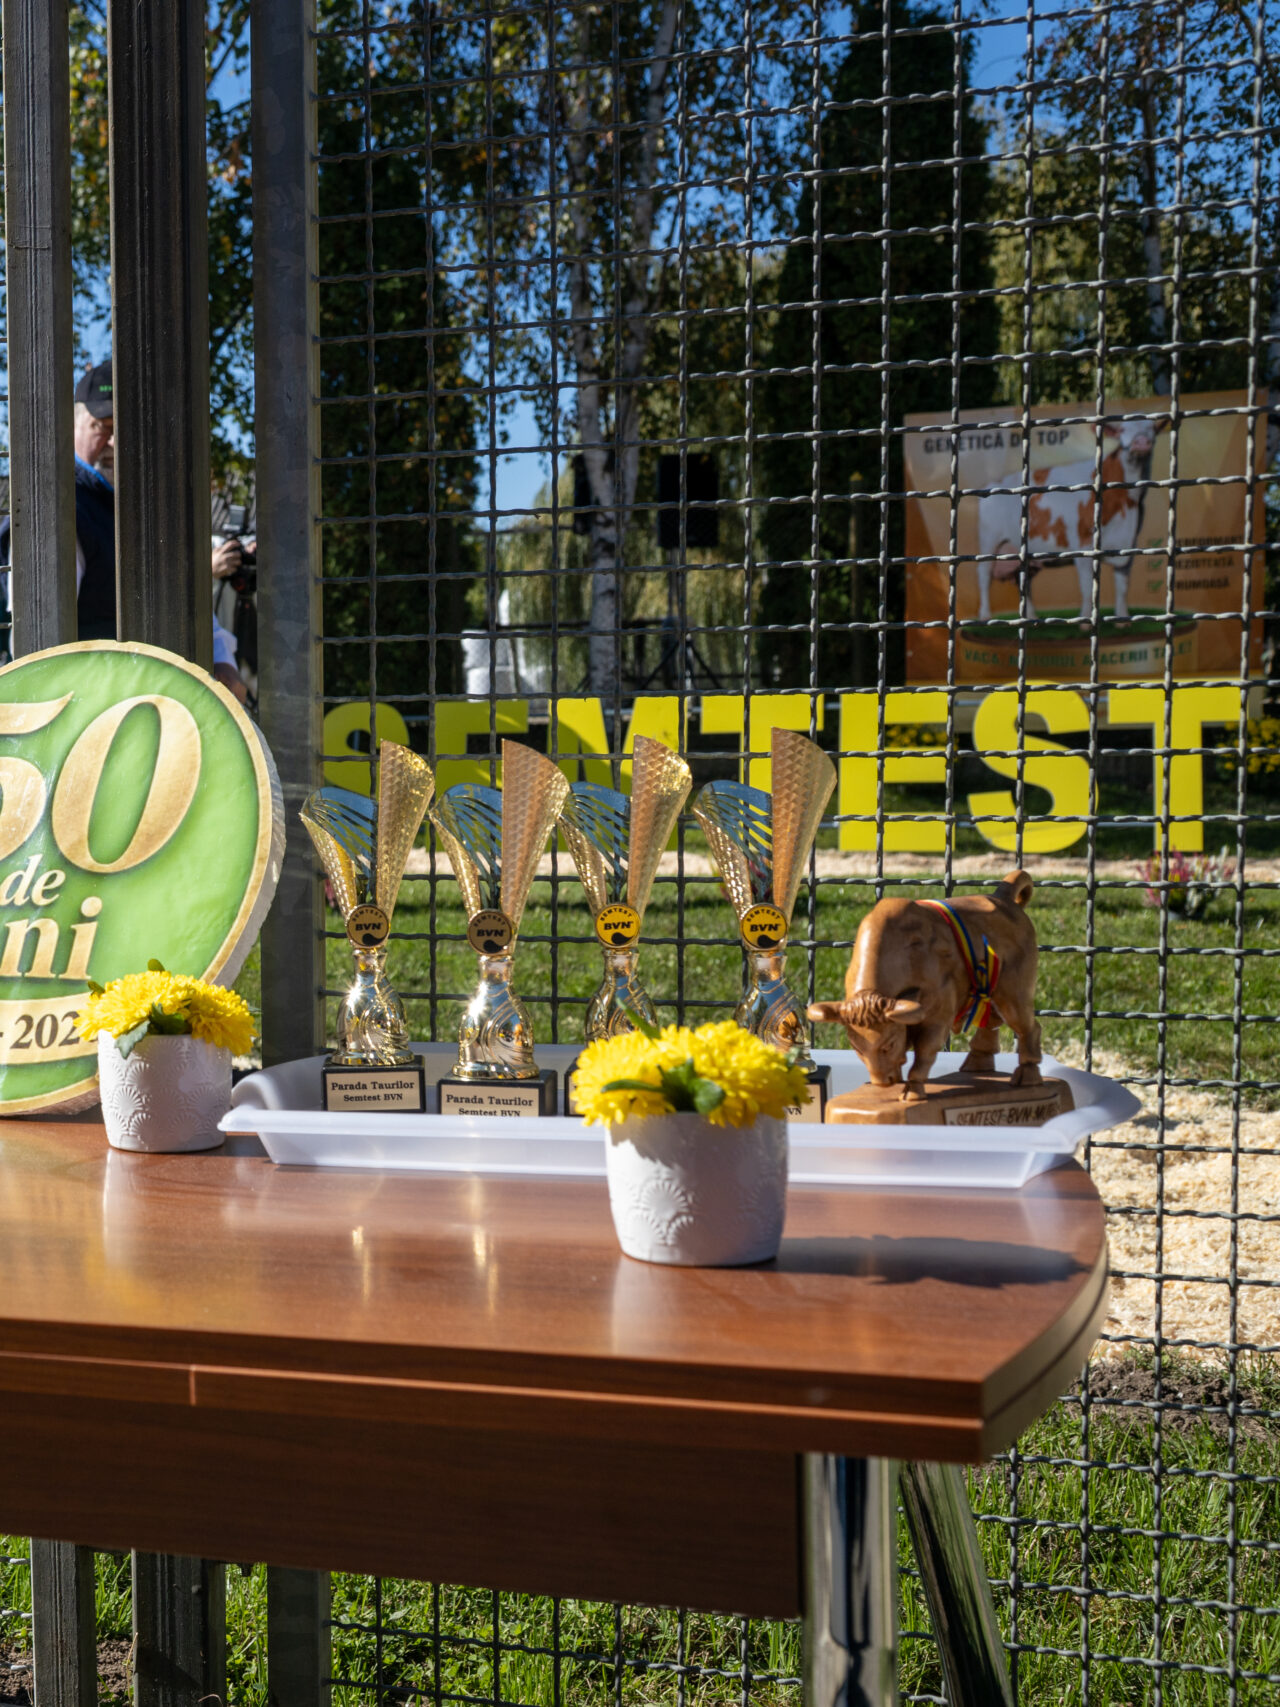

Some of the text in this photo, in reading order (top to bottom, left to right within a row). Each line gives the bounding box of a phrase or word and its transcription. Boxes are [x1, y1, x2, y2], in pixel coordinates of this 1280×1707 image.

[1038, 430, 1069, 446] TOP
[1083, 649, 1148, 665] AACERII
[322, 679, 1248, 854] SEMTEST
[352, 907, 383, 922] SEMTEST
[473, 914, 506, 927] SEMTEST
[600, 907, 632, 921] SEMTEST
[746, 908, 781, 922] SEMTEST
[10, 1011, 98, 1050] 202
[331, 1080, 415, 1091] Parada Taurilor
[343, 1093, 403, 1102] Semtest BVN
[446, 1094, 534, 1107] Parada Taurilor
[458, 1107, 498, 1116] Semtest
